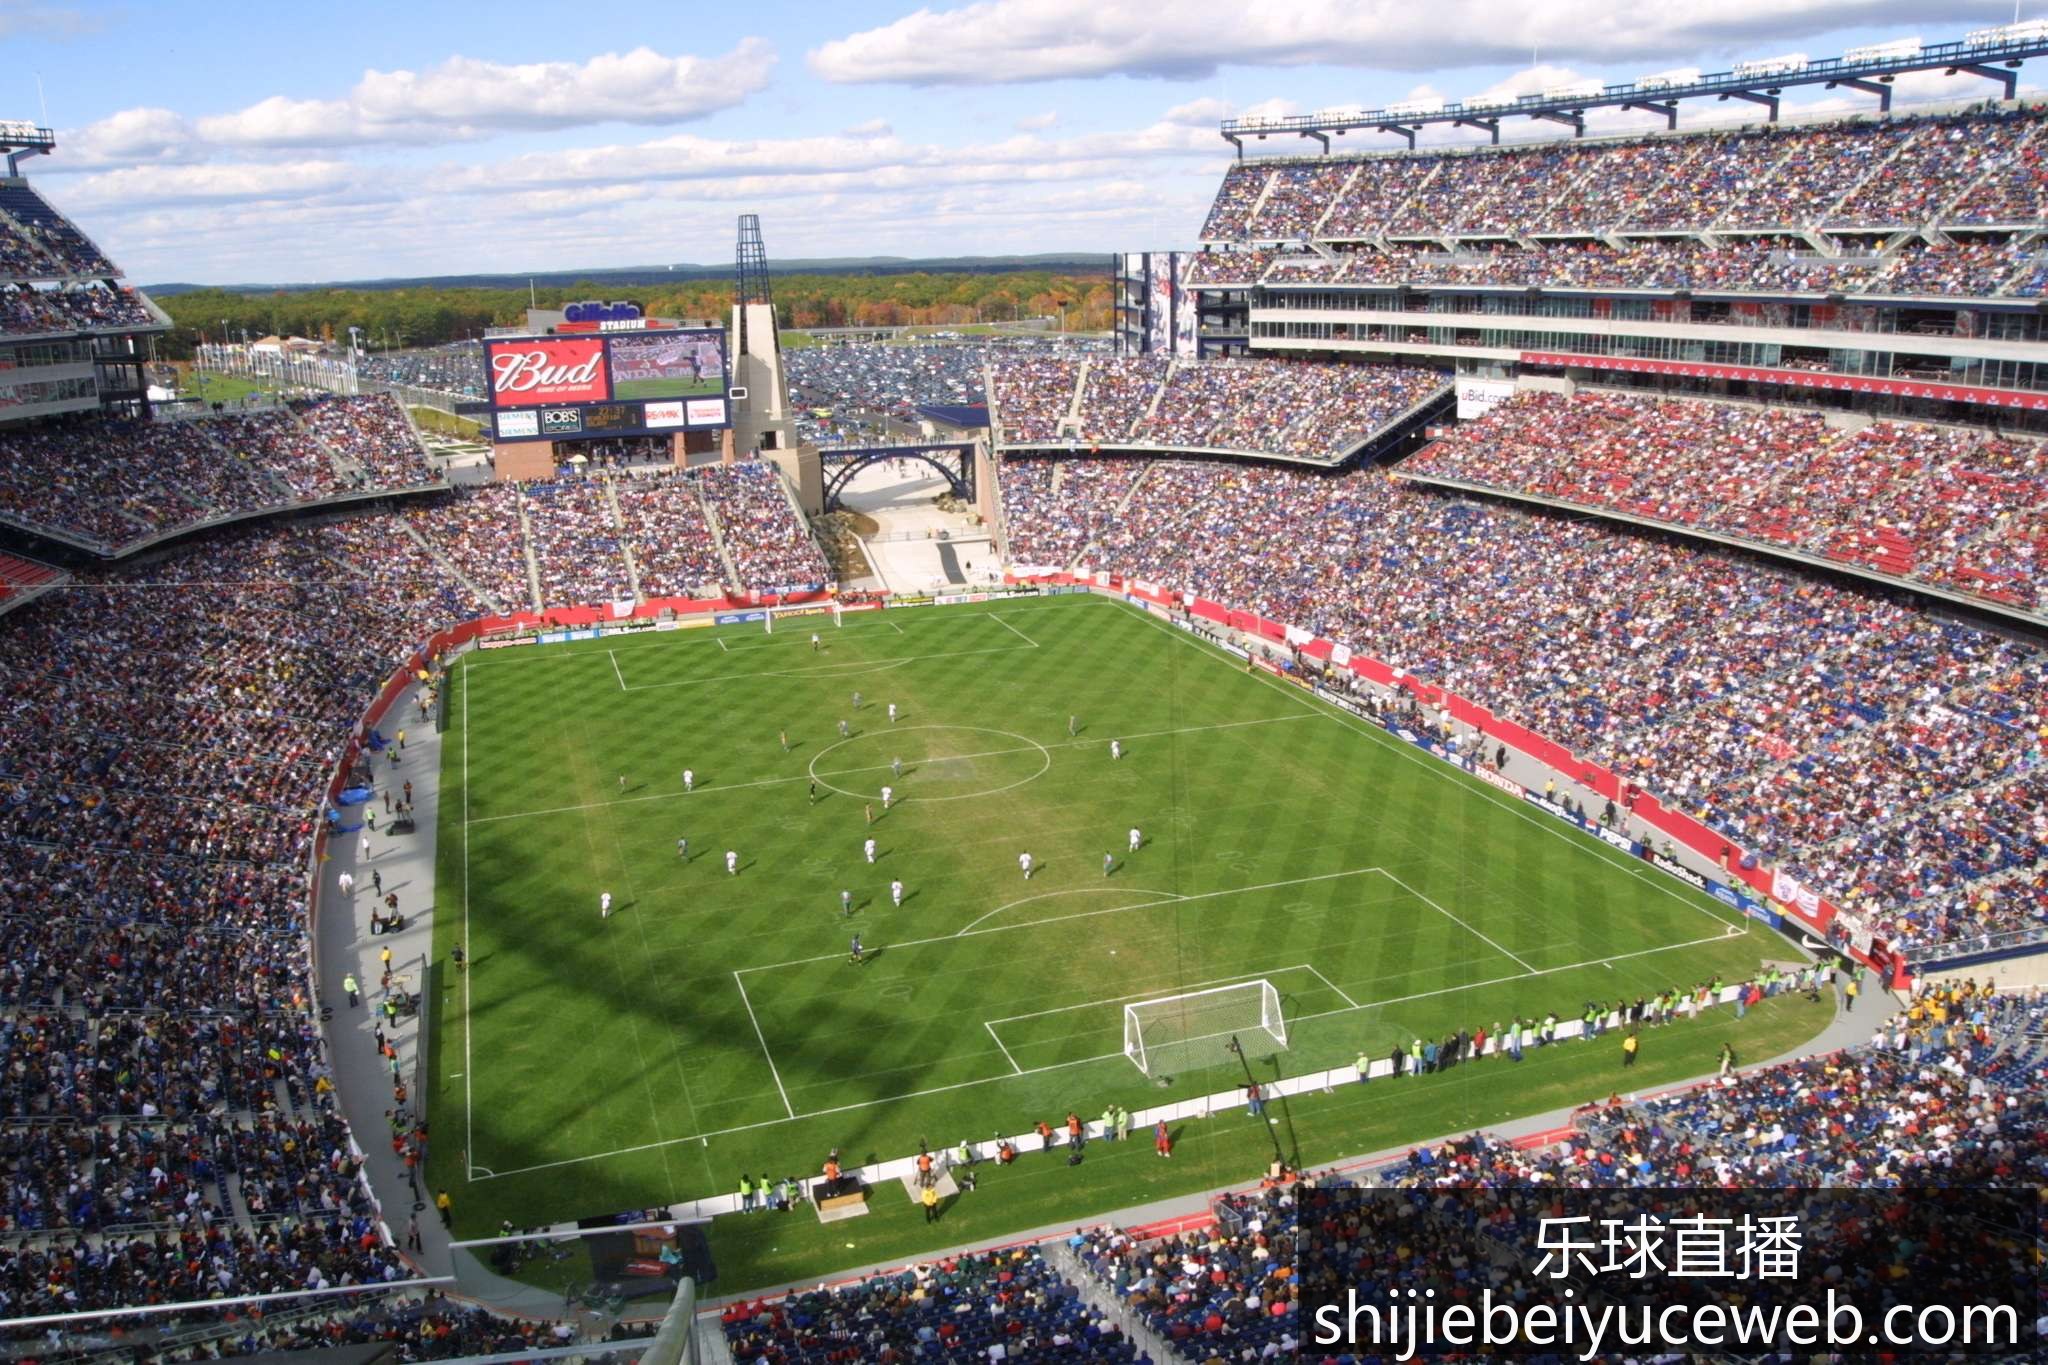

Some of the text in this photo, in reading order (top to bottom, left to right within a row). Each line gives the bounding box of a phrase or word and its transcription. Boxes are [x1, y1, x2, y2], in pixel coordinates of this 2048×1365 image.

[600, 320, 646, 331] STADIUM
[492, 351, 602, 392] Bud
[1474, 764, 1525, 800] HONDA
[1600, 827, 1633, 851] PEPSI
